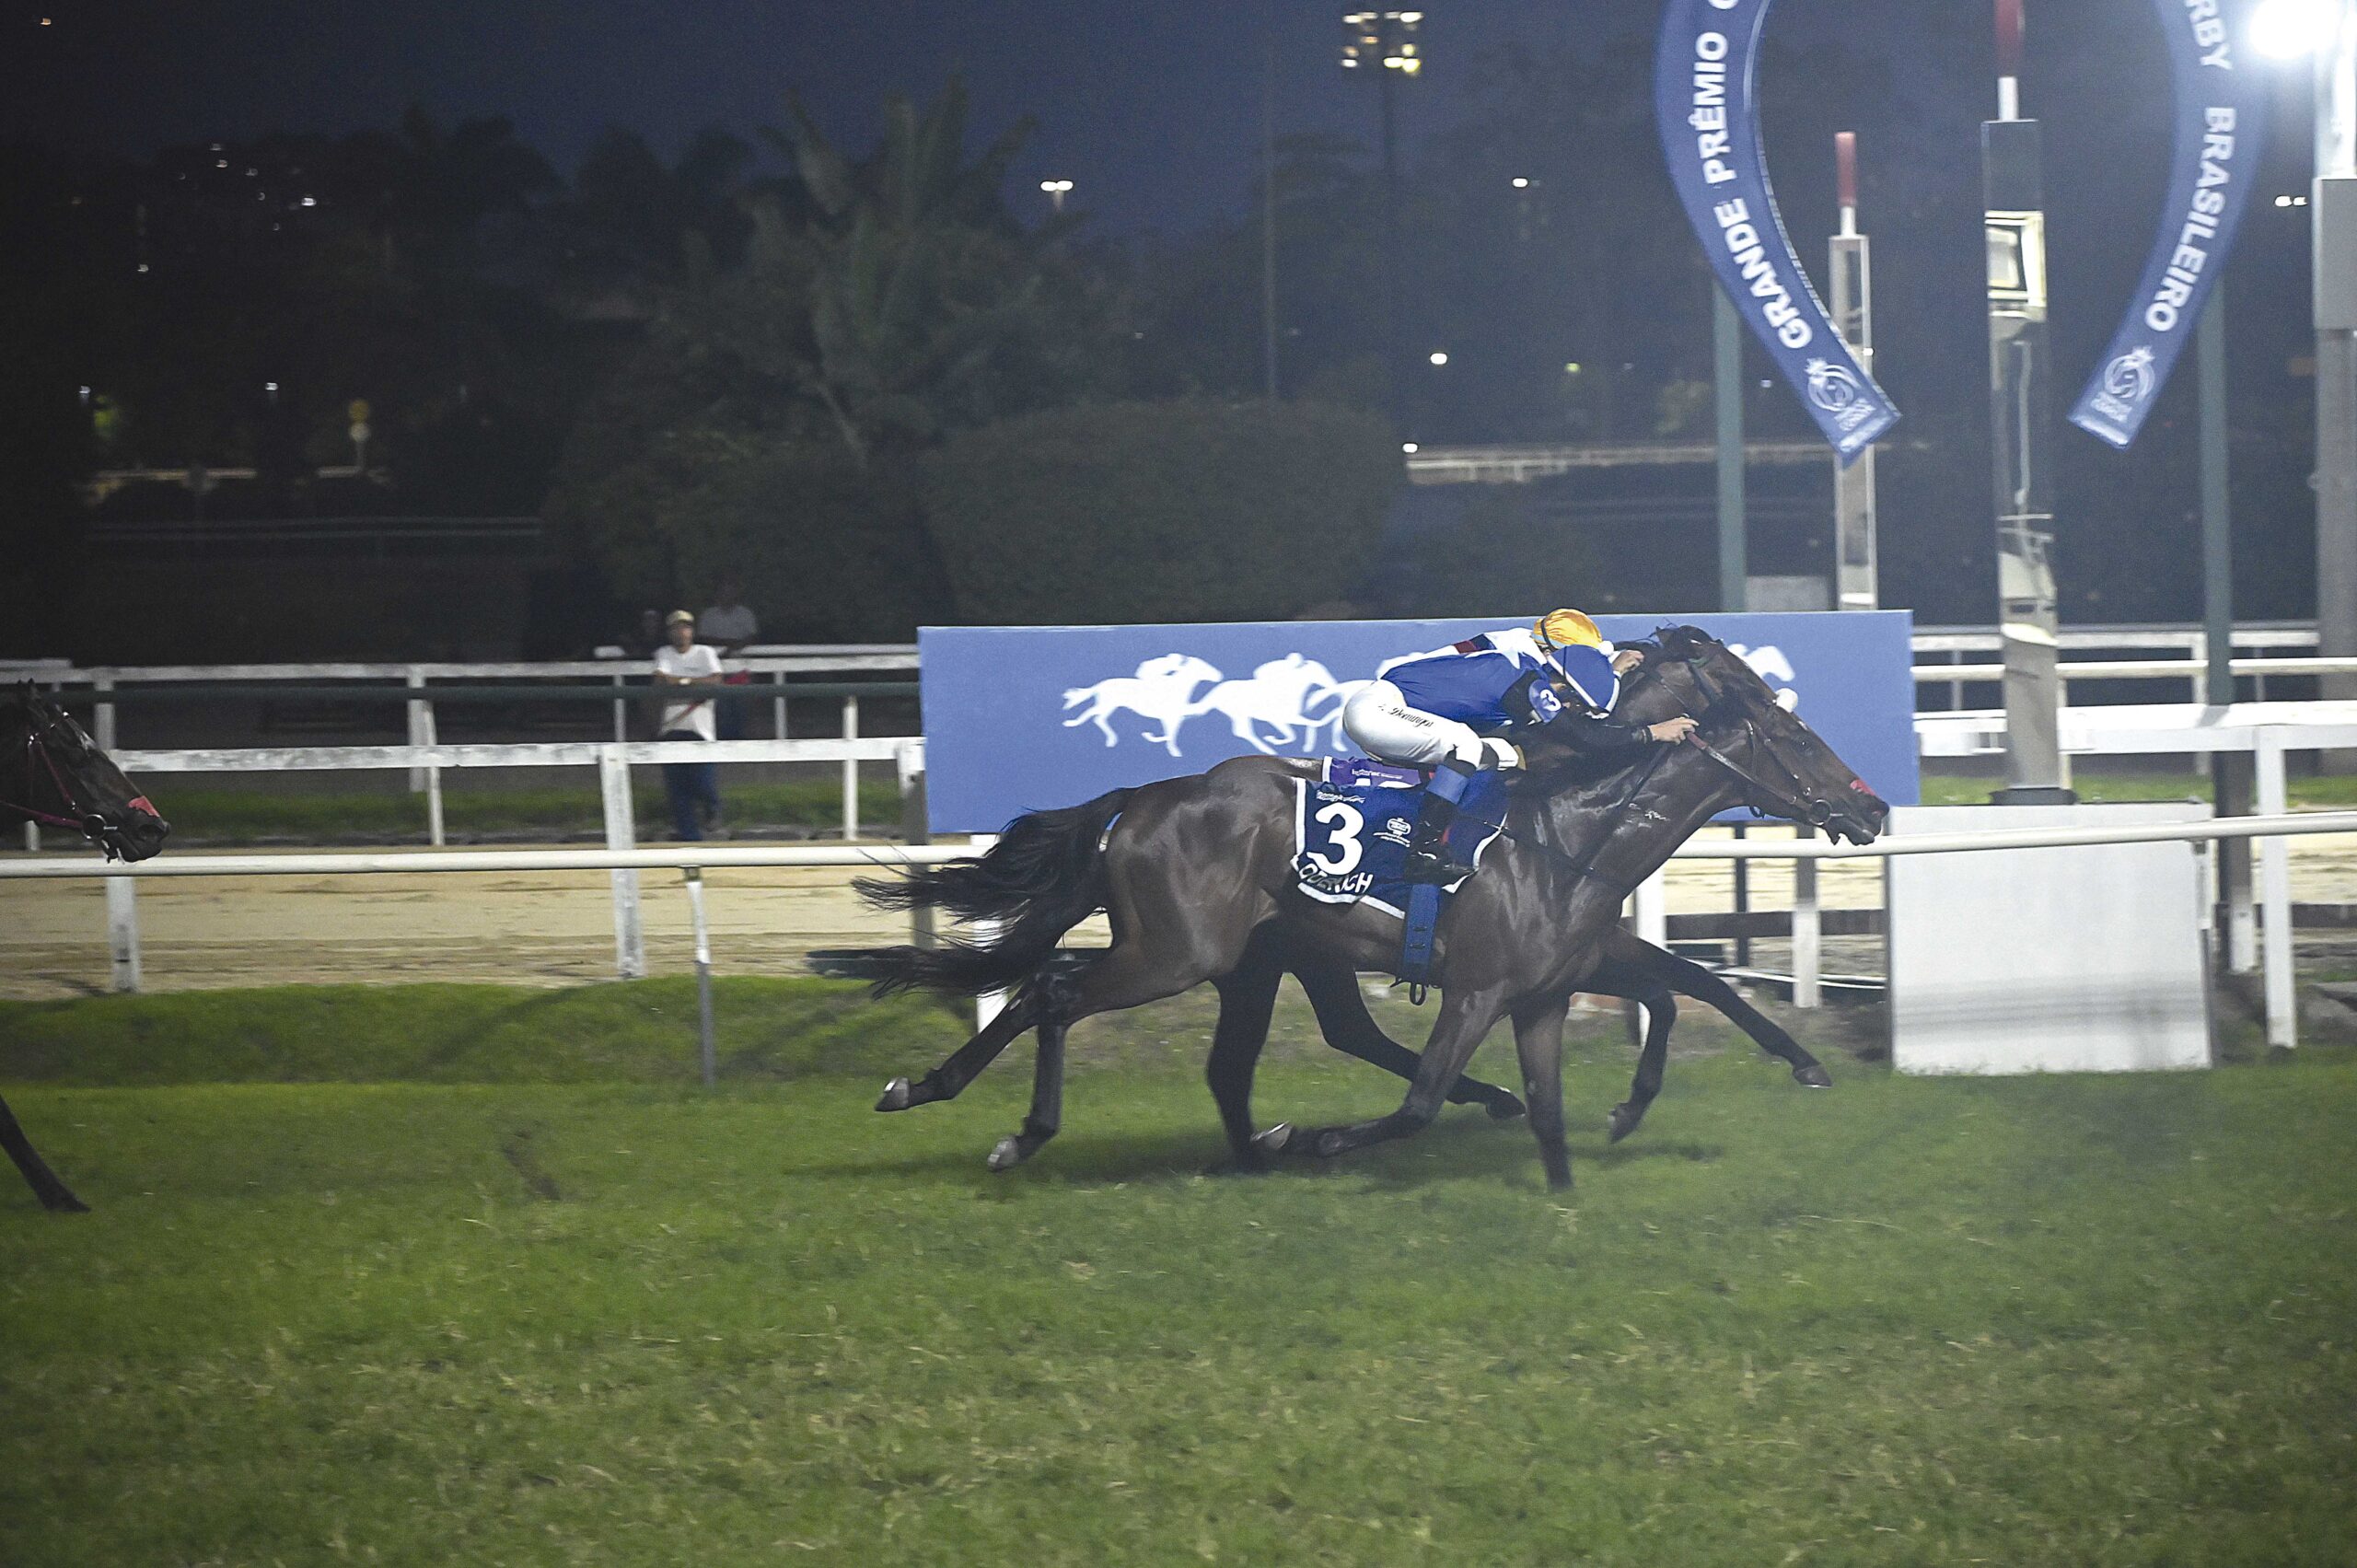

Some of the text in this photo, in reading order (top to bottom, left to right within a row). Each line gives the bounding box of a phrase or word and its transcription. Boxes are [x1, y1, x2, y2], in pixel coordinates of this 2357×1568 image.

[1688, 31, 1736, 184] PRÊMIO
[1714, 198, 1812, 348] GRANDE
[2145, 107, 2235, 331] BRASILEIRO
[1539, 689, 1562, 712] 3
[1306, 802, 1364, 876] 3
